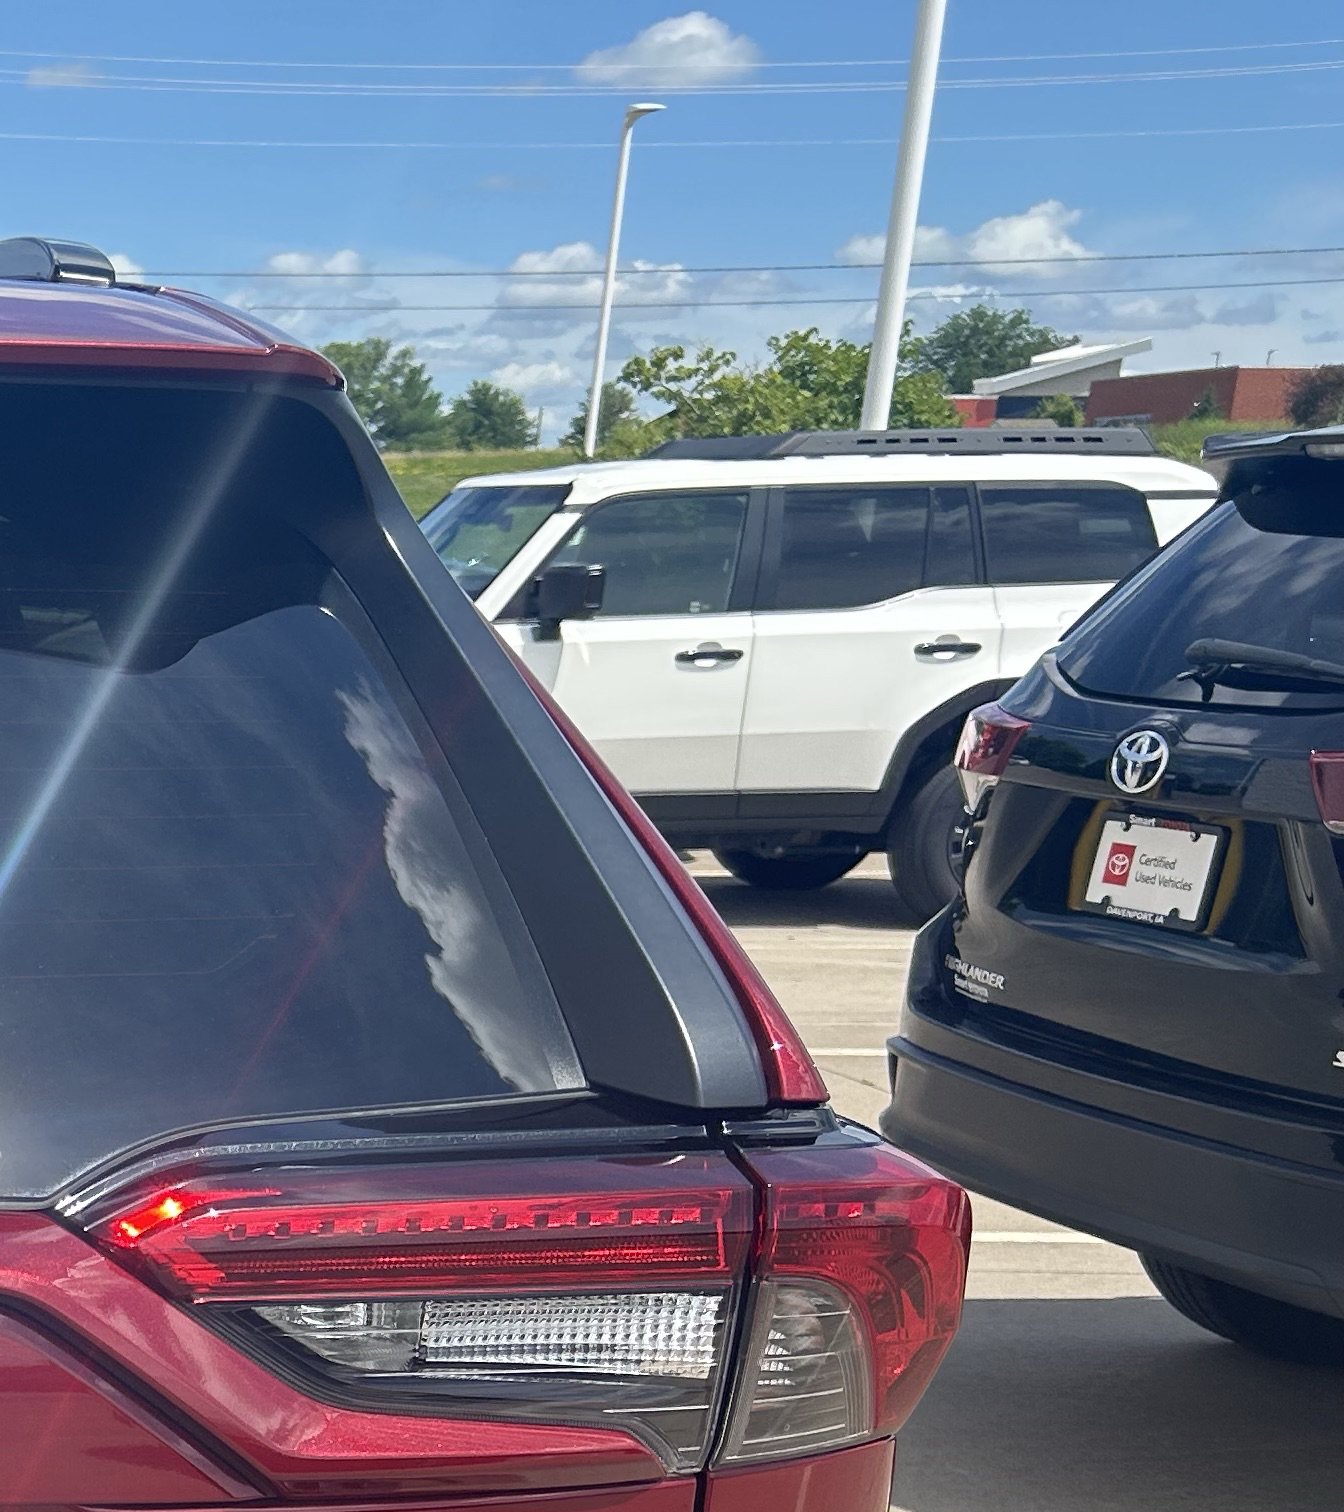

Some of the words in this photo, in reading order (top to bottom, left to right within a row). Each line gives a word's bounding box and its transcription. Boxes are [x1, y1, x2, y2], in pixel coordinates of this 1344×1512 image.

[1139, 854, 1177, 870] Certified
[1135, 871, 1157, 884] Used
[1158, 873, 1193, 891] Vehicles
